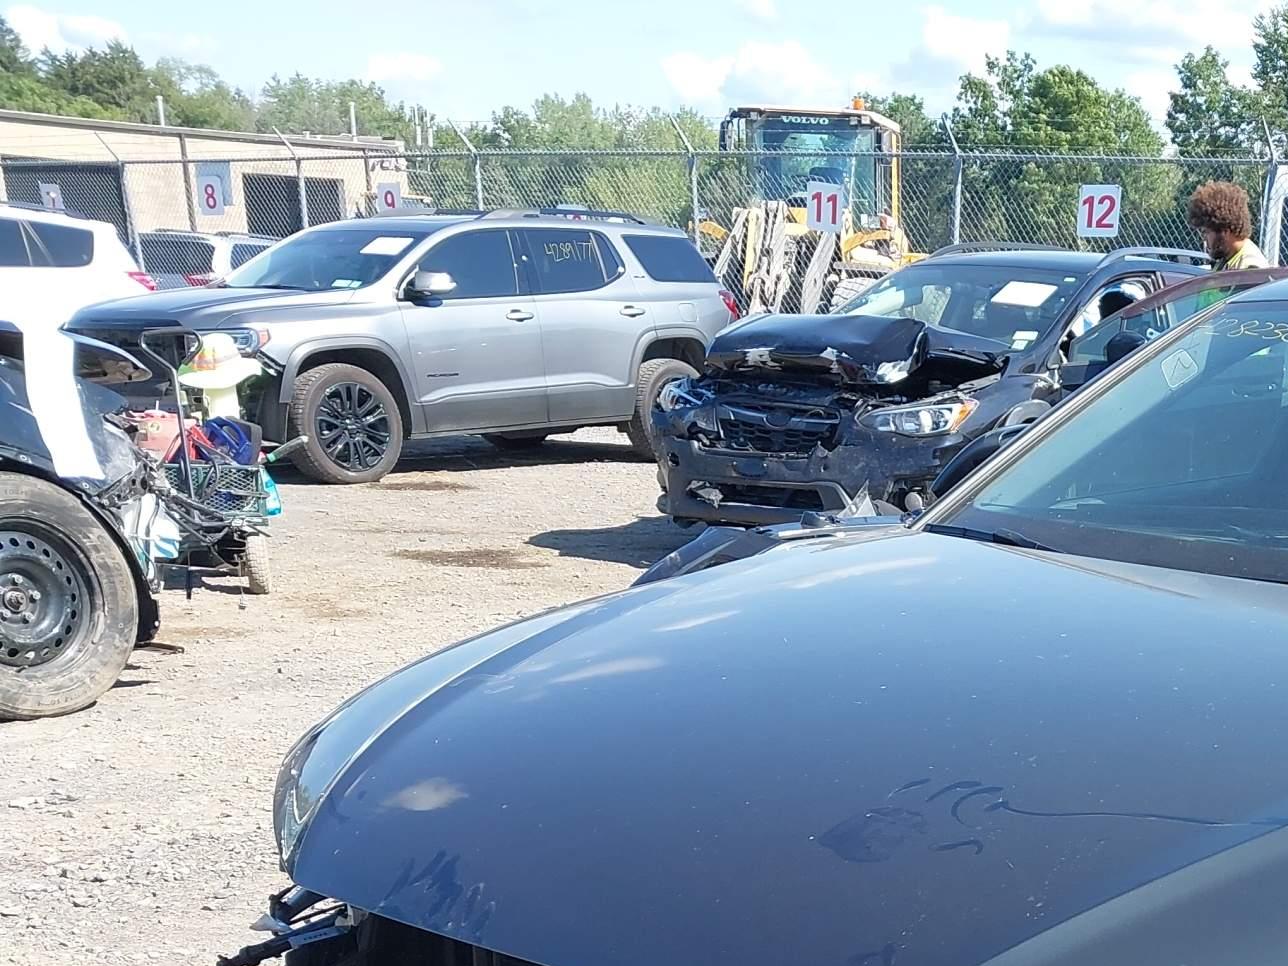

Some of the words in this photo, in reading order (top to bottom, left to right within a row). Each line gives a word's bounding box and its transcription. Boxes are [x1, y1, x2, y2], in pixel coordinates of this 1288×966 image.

[781, 115, 830, 125] VOLVO
[204, 183, 217, 209] 8
[811, 191, 838, 225] 11
[1082, 194, 1116, 228] 12
